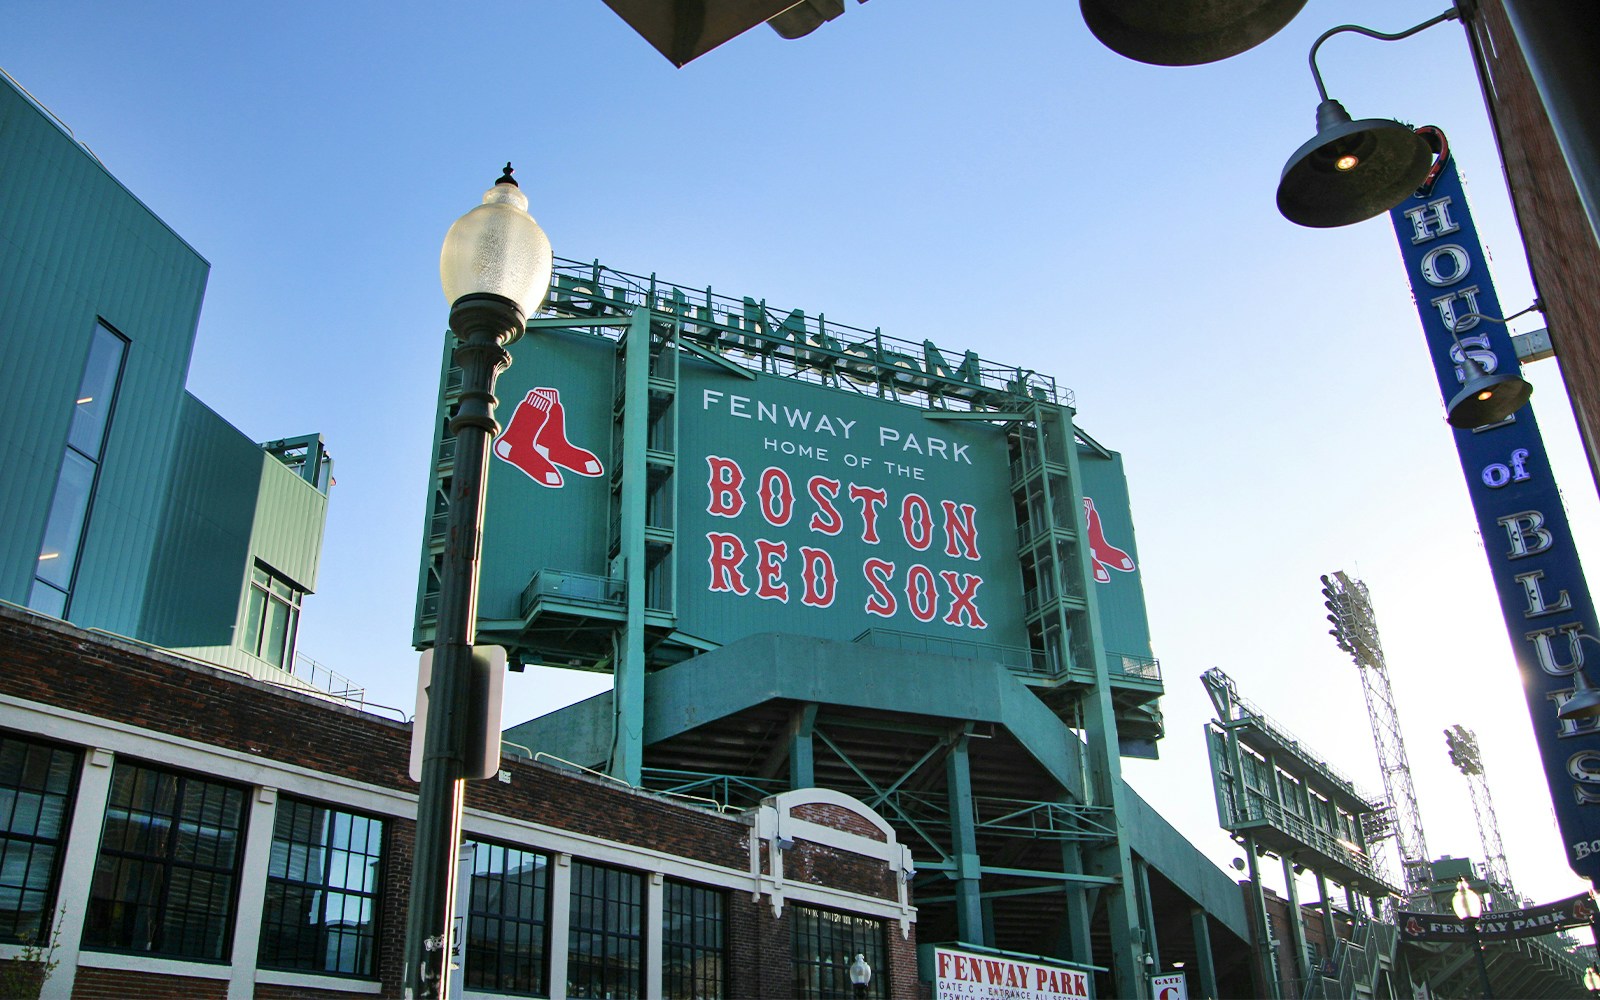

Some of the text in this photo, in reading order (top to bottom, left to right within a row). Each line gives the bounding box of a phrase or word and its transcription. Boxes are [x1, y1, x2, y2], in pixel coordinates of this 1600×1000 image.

[703, 388, 972, 465] FENWAY PARK
[764, 437, 925, 481] HOME OF THE
[1481, 447, 1531, 488] of
[705, 455, 981, 561] BOSTON
[705, 532, 988, 629] RED SOX
[1513, 911, 1567, 930] PARK
[937, 952, 1087, 997] FENWAY PARK
[938, 981, 963, 992] GATE
[968, 984, 974, 993] C
[988, 987, 1031, 1000] ENTRANCE
[1154, 976, 1182, 986] GATE
